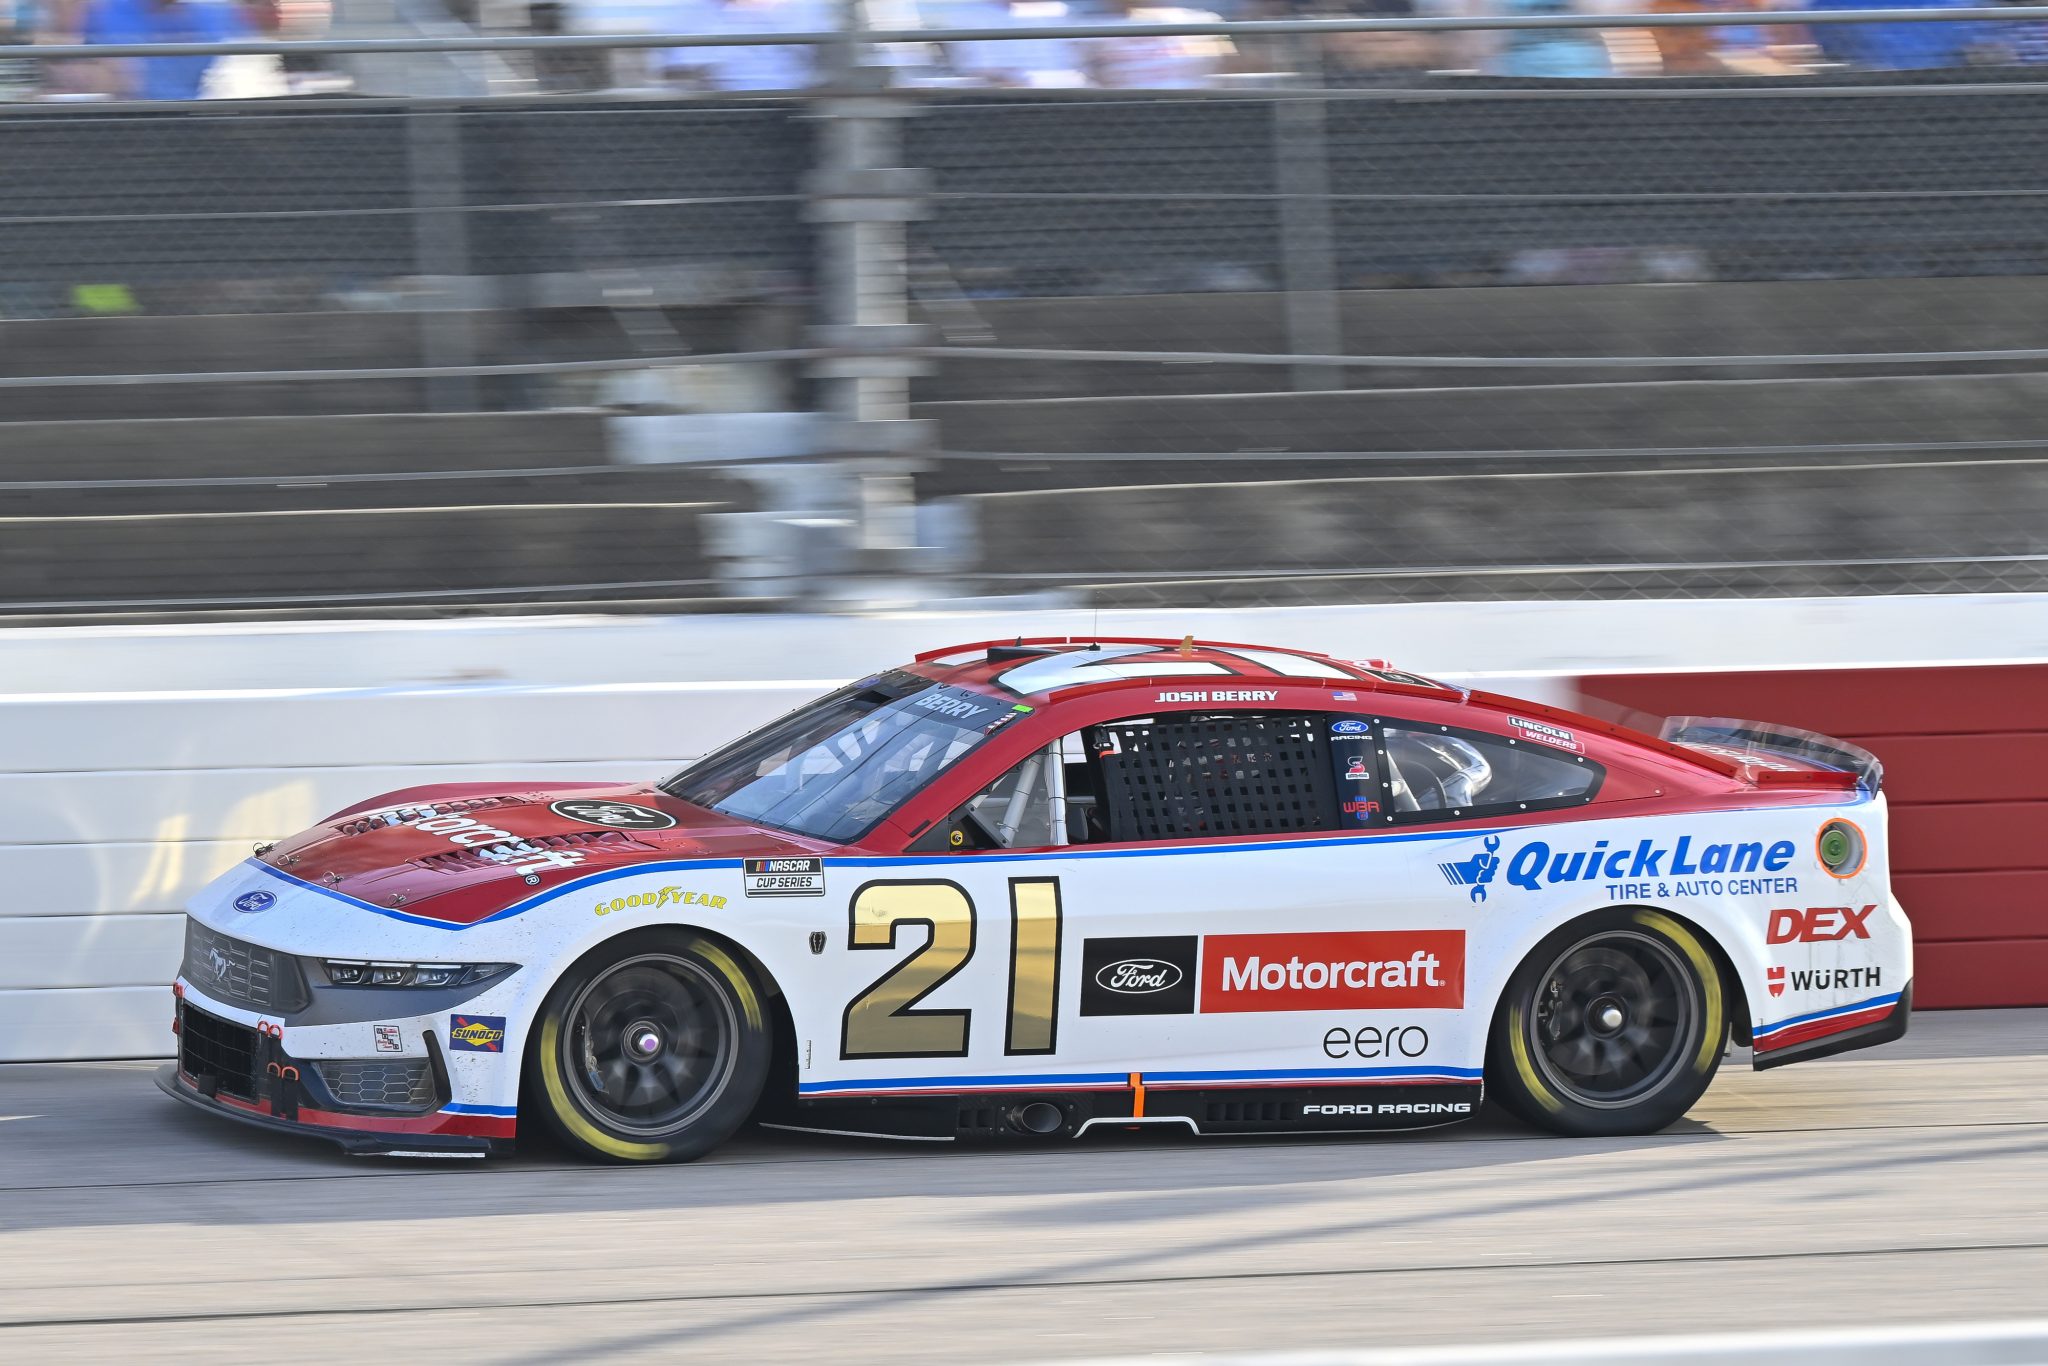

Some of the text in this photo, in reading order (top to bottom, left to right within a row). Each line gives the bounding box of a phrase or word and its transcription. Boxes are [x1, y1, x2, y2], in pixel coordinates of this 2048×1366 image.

[914, 693, 989, 719] BERRY
[1154, 690, 1279, 703] JOSH BERRY
[1339, 722, 1362, 732] Ford
[1511, 718, 1570, 740] LINCOLN
[1526, 730, 1577, 750] WELDERS
[768, 860, 811, 872] NASCAR
[756, 876, 813, 888] CUP SERIES
[1606, 877, 1798, 901] TIRE & AUTO CENTER
[594, 886, 728, 916] GOODYEAR
[1766, 904, 1878, 945] DEX
[839, 875, 1063, 1061] 21
[1110, 963, 1168, 989] Ford
[1790, 966, 1881, 991] WÜRTH
[453, 1029, 502, 1040] SUNOCO
[1322, 1025, 1429, 1059] eero
[1303, 1103, 1472, 1115] FORD RACING
